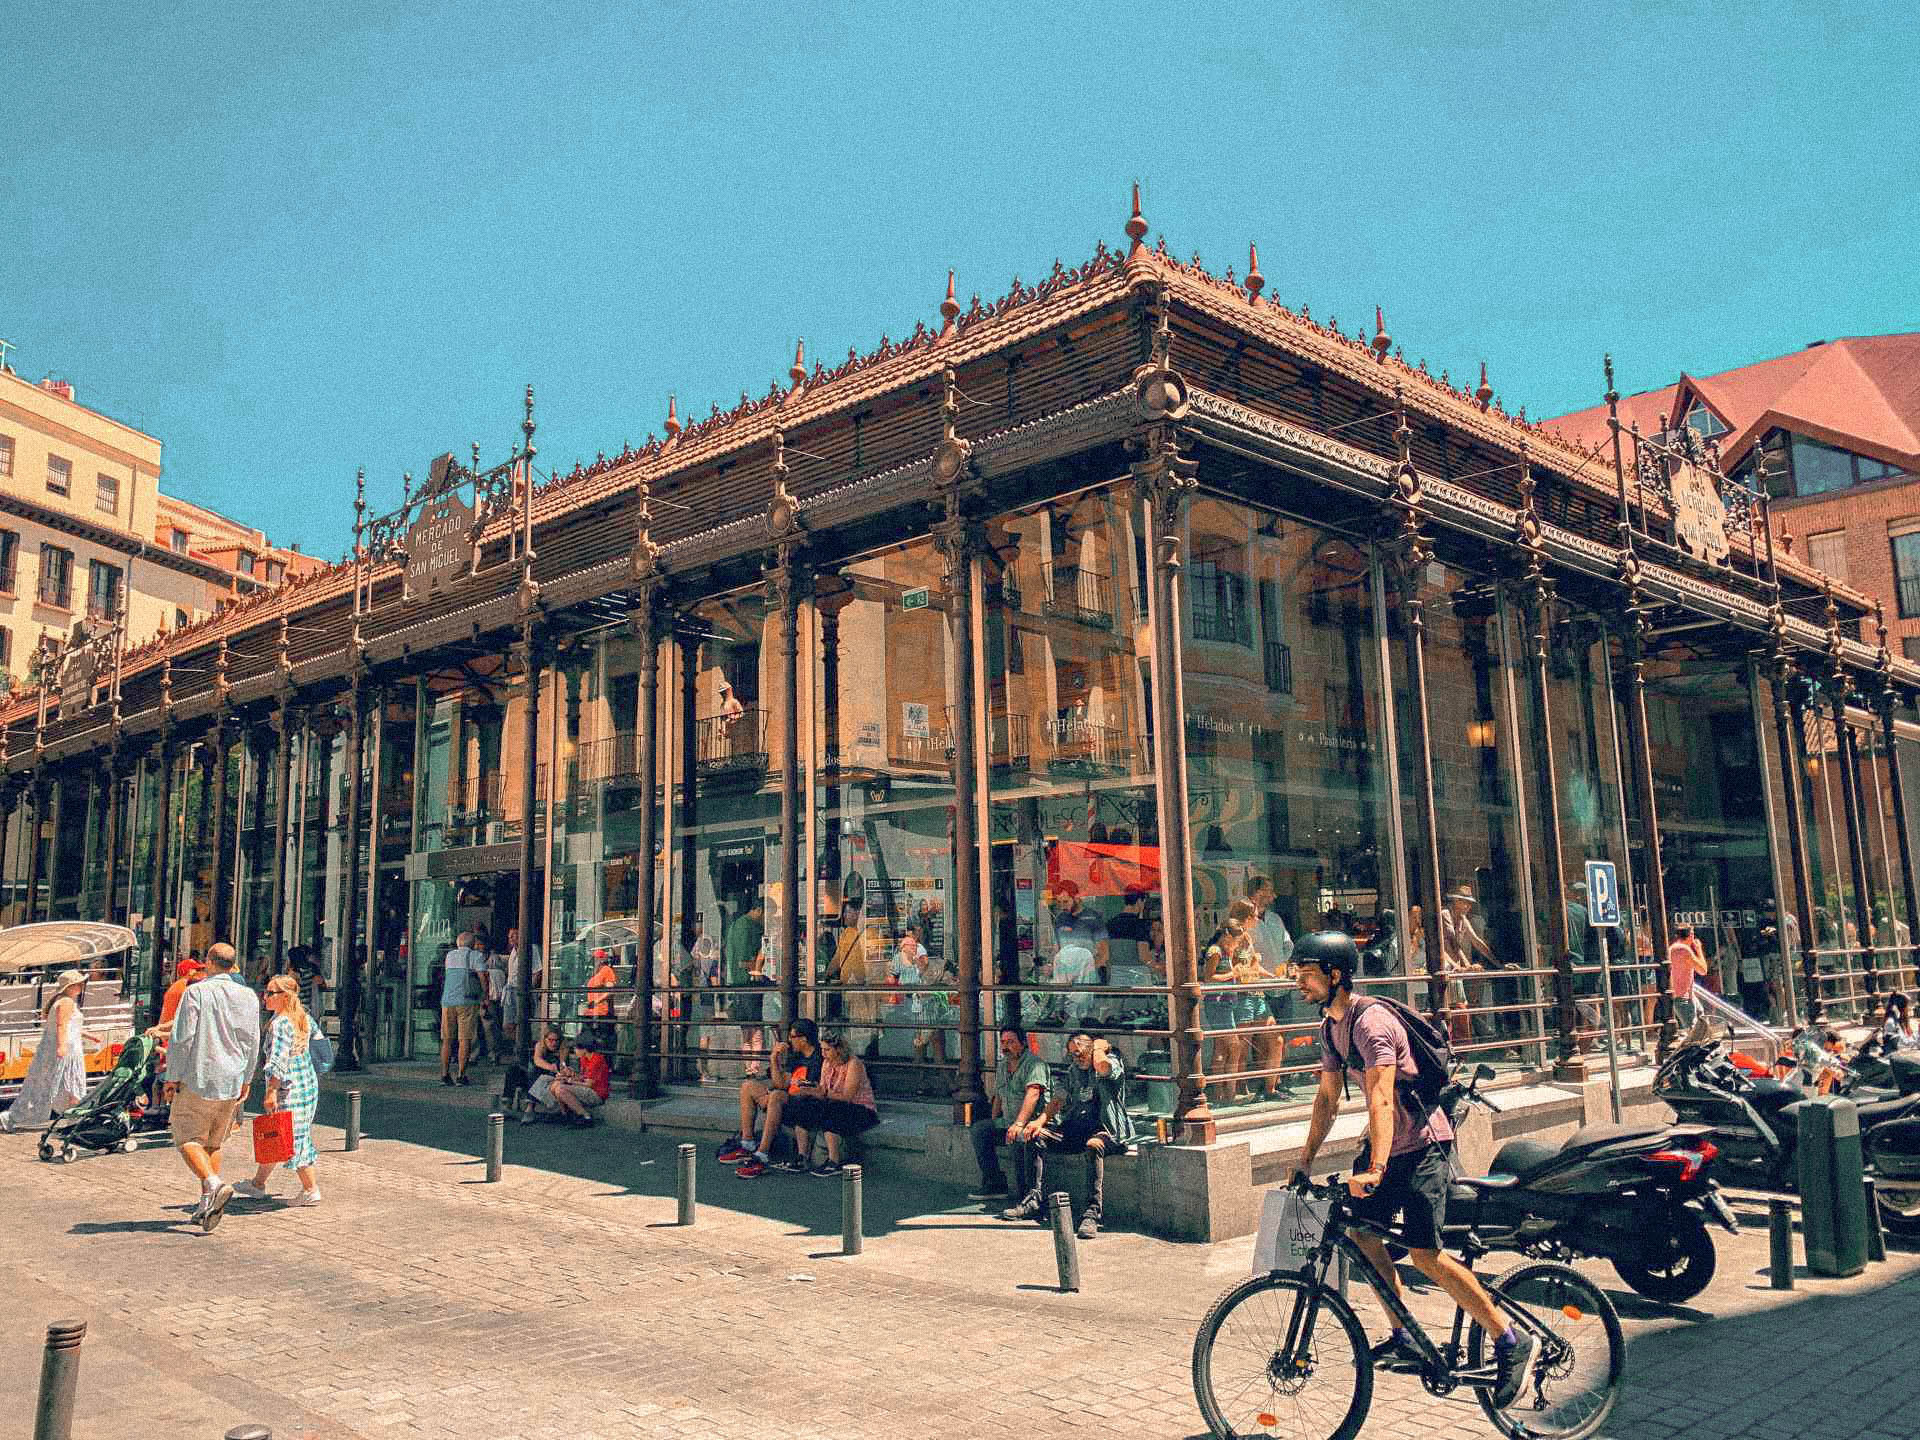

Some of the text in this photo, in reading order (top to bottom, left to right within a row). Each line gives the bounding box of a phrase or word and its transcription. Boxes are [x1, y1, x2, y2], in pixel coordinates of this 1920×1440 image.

[415, 515, 461, 546] MERCADO
[431, 539, 443, 552] DE
[410, 547, 460, 578] SAN MIGUEL
[1595, 868, 1609, 920] P
[1289, 1228, 1316, 1242] Uber
